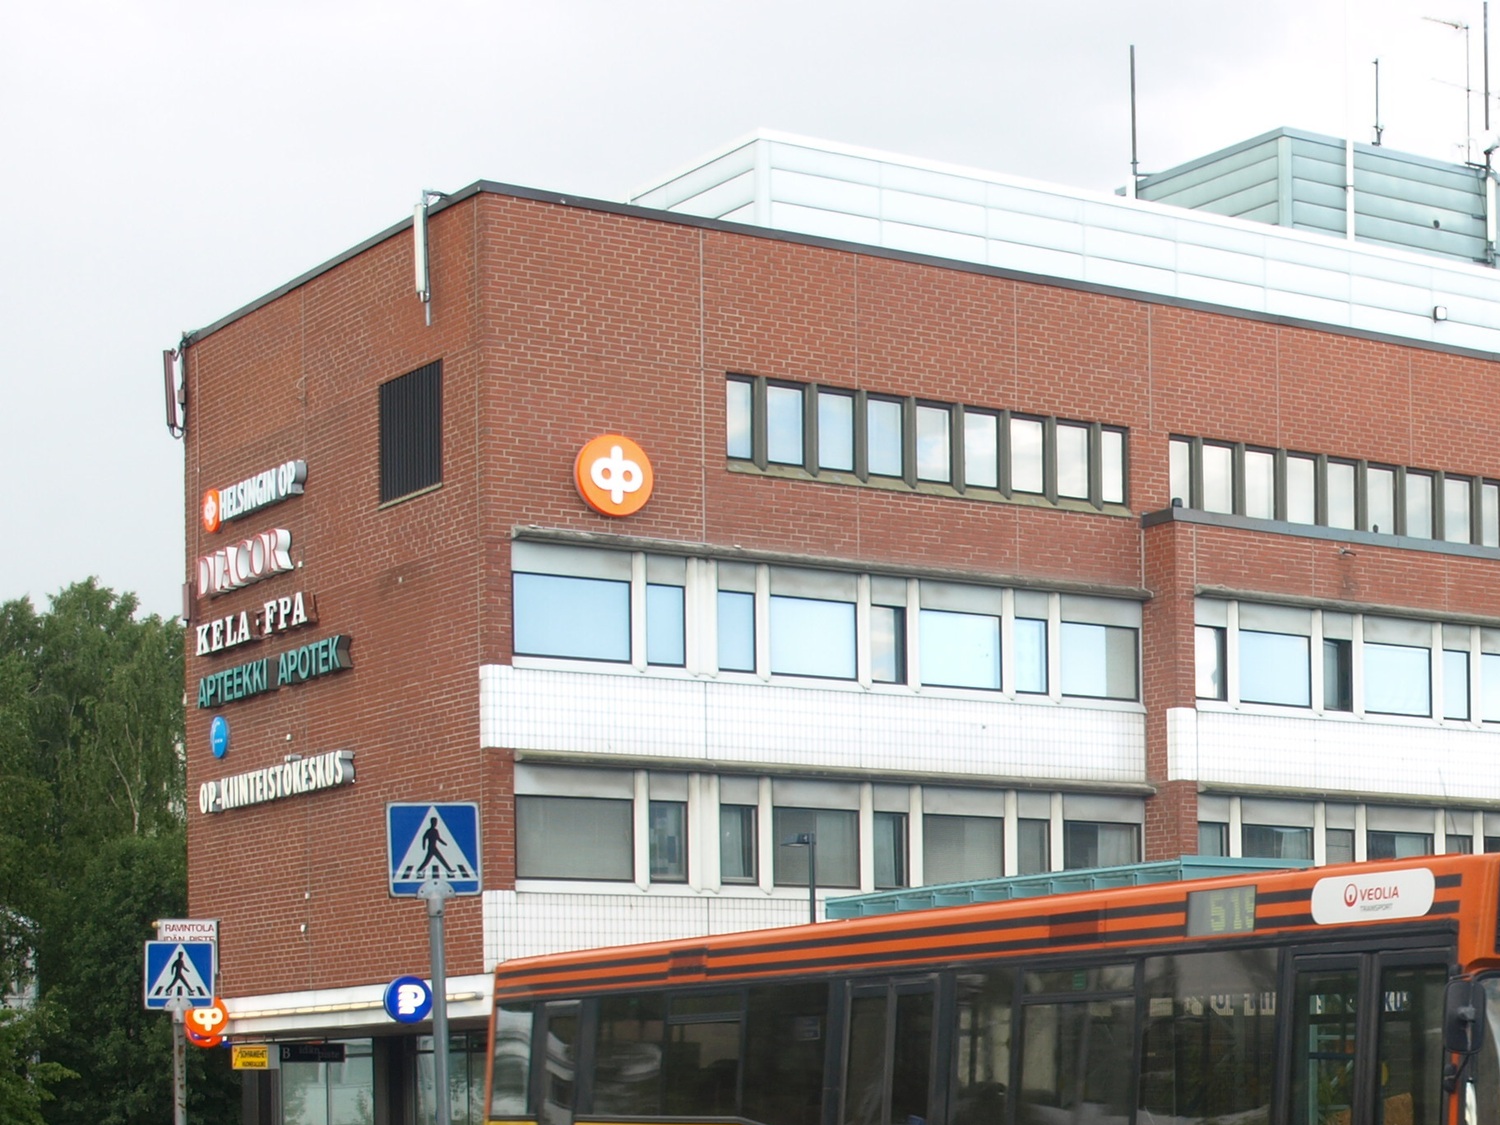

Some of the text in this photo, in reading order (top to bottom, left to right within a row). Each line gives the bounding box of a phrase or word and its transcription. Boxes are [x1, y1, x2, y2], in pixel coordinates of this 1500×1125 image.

[219, 460, 297, 523] HELSINGIN OP
[197, 528, 290, 598] DIACOR
[196, 591, 308, 657] KELA FPA
[197, 635, 341, 708] APTEEKKI APOTEK
[200, 750, 344, 814] OP-KIINTEISTÖKESKUS
[1359, 886, 1400, 901] VEOLIA
[1359, 903, 1394, 912] TRANSPORT
[165, 924, 215, 932] RAVINTOLA
